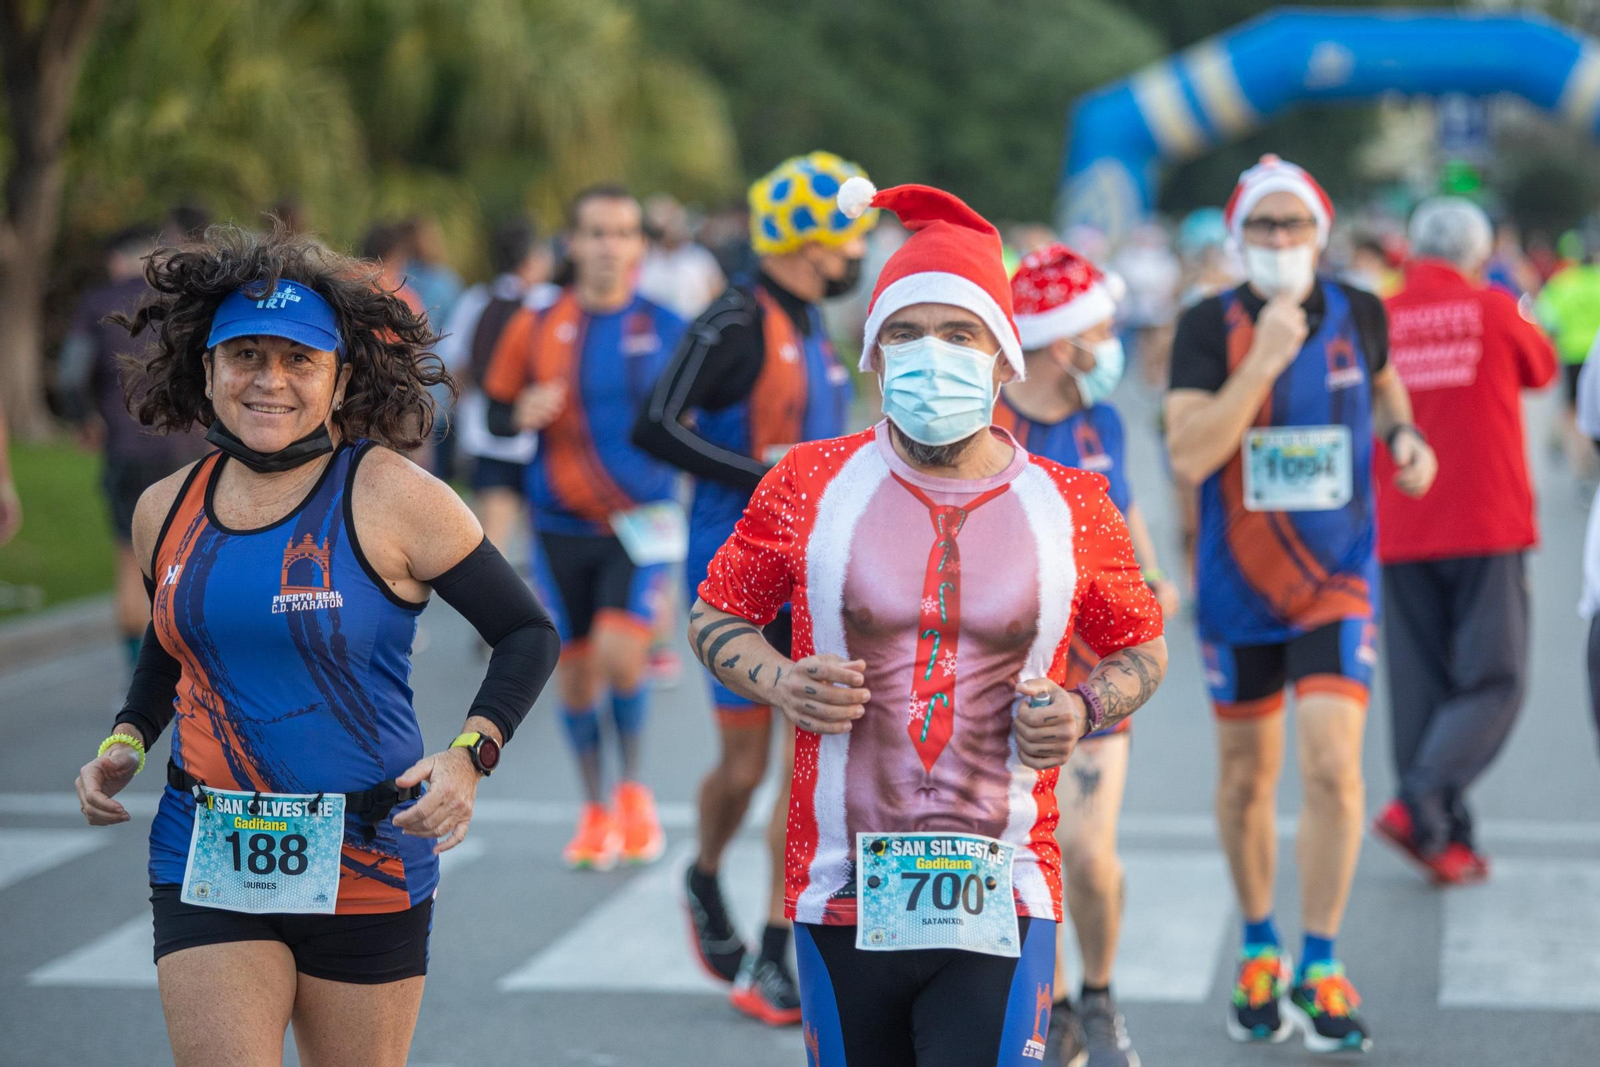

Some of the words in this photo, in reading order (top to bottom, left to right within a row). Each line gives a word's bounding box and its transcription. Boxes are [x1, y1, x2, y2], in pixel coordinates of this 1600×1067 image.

[272, 592, 313, 604] PUERTO
[315, 590, 342, 600] REAL
[271, 603, 289, 614] C.D.
[216, 798, 243, 814] SAN
[234, 816, 288, 831] Gaditana
[226, 831, 309, 876] 188
[891, 840, 925, 856] SAN
[916, 857, 972, 870] Gaditana
[243, 880, 277, 890] LOURDES
[900, 872, 984, 915] 700
